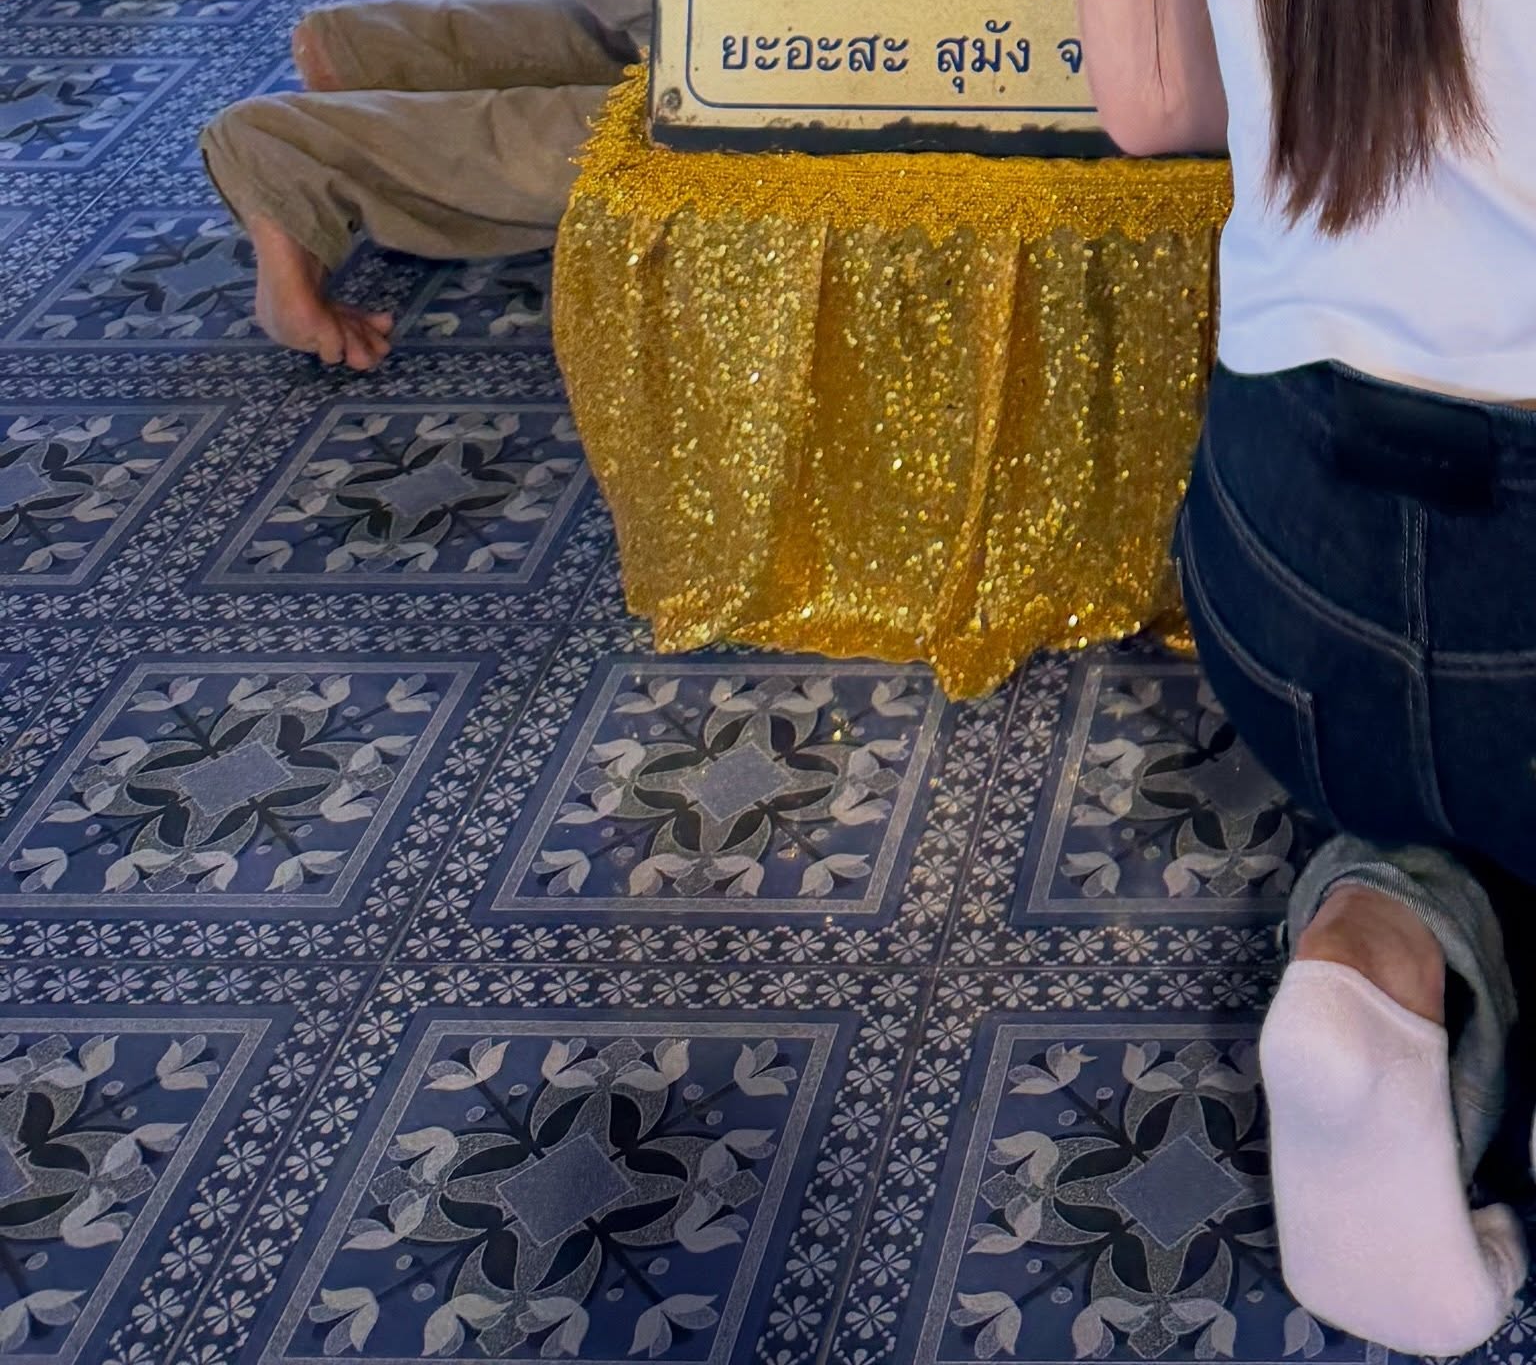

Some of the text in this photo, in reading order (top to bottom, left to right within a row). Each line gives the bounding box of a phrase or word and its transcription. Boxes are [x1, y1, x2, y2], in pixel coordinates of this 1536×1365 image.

[721, 33, 910, 72] ยะอะสะ
[936, 19, 1031, 94] สุมัง
